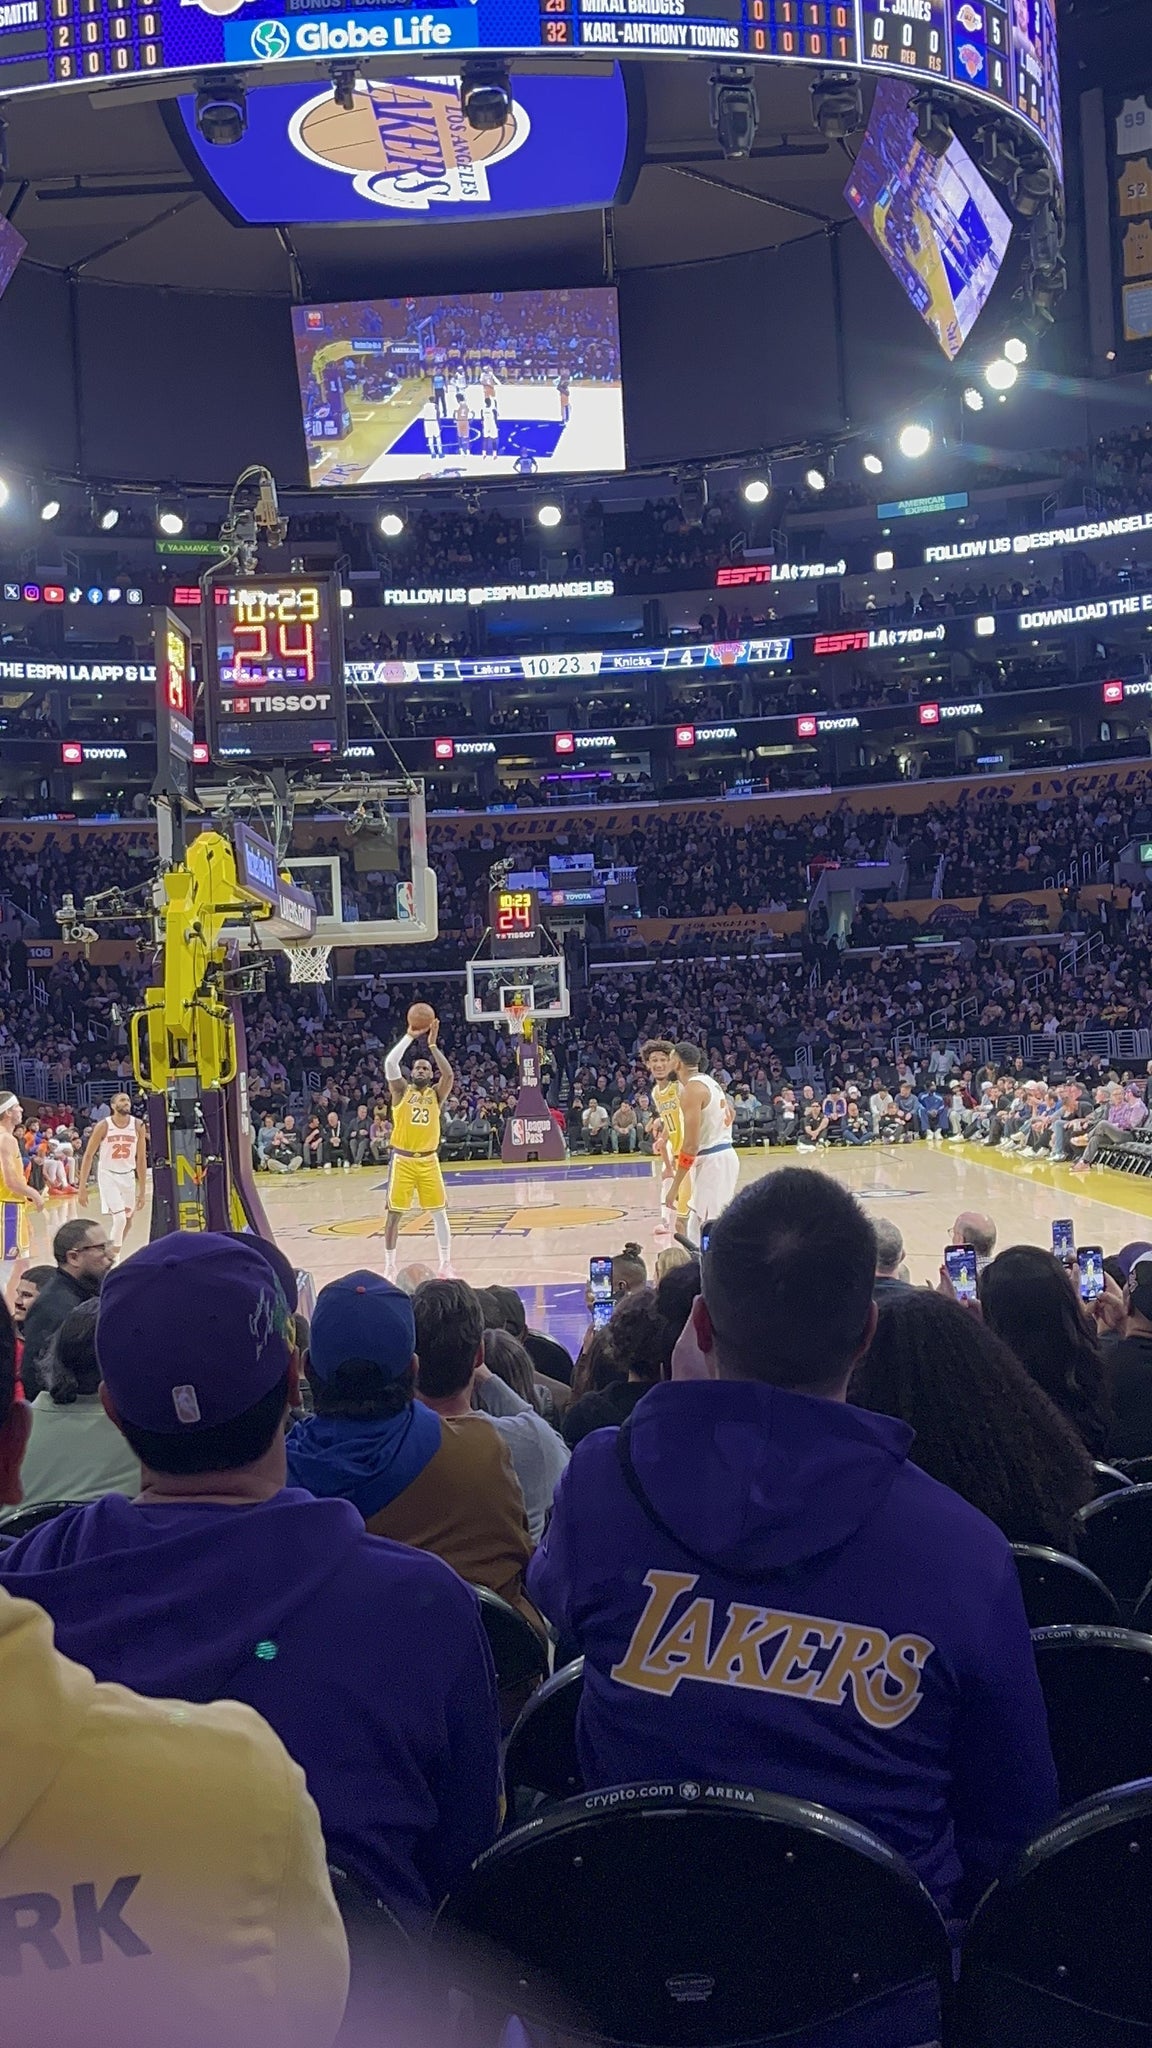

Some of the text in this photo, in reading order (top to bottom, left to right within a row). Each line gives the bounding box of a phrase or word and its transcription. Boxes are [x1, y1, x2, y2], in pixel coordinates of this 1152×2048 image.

[630, 0, 685, 15] BRIDGES
[892, 0, 932, 22] JAMES
[59, 14, 155, 47] 2 0 0 0
[296, 15, 452, 51] Globe Life
[546, 21, 847, 57] 32 KARL-ANTHONY TOWNS 0 0 0 1
[873, 18, 939, 53] 0 0 0
[992, 17, 1001, 45] 5
[60, 44, 156, 77] 3 0 0 0
[871, 44, 942, 72] AST REB FLS
[994, 60, 1002, 87] 4
[1123, 111, 1146, 129] 99
[445, 105, 479, 197] LOS ANGELES
[1127, 182, 1148, 199] 52
[898, 495, 945, 509] AMERICAN
[904, 503, 947, 515] EXPRESS
[925, 540, 987, 563] FOLLOW
[989, 537, 1011, 554] US
[717, 566, 771, 586] ESPN
[384, 580, 615, 605] FOLLOW US @ESPNLOSANGELES
[1020, 602, 1108, 629] DOWNLOAD
[1109, 597, 1140, 617] THE
[814, 632, 869, 654] ESPN
[233, 623, 314, 684] 24
[26, 663, 67, 680] ESPN
[70, 664, 91, 681] LA
[91, 665, 124, 682] APP
[125, 666, 138, 682] &
[433, 663, 444, 680] 5
[473, 664, 511, 675] Lakers
[528, 656, 580, 676] 10:23
[613, 655, 652, 668] Knicks
[680, 650, 693, 666] 4
[250, 694, 331, 713] TISSOT
[940, 703, 984, 716] TOYOTA
[695, 727, 738, 740] TOYOTA
[818, 717, 860, 730] TOYOTA
[454, 742, 496, 754] TOYOTA
[575, 736, 617, 748] TOYOTA
[83, 748, 128, 760] TOYOTA
[500, 893, 531, 908] 10:23
[499, 907, 531, 930] 24
[507, 931, 535, 940] TISSOT
[411, 1106, 430, 1124] 23
[664, 1112, 677, 1132] 11
[525, 1119, 551, 1133] League
[525, 1132, 544, 1145] Pass
[111, 1143, 132, 1159] 25
[1093, 1629, 1128, 1640] ARENA
[610, 1568, 936, 1729] LAKERS
[584, 1782, 755, 1809] crypto.com ARENA
